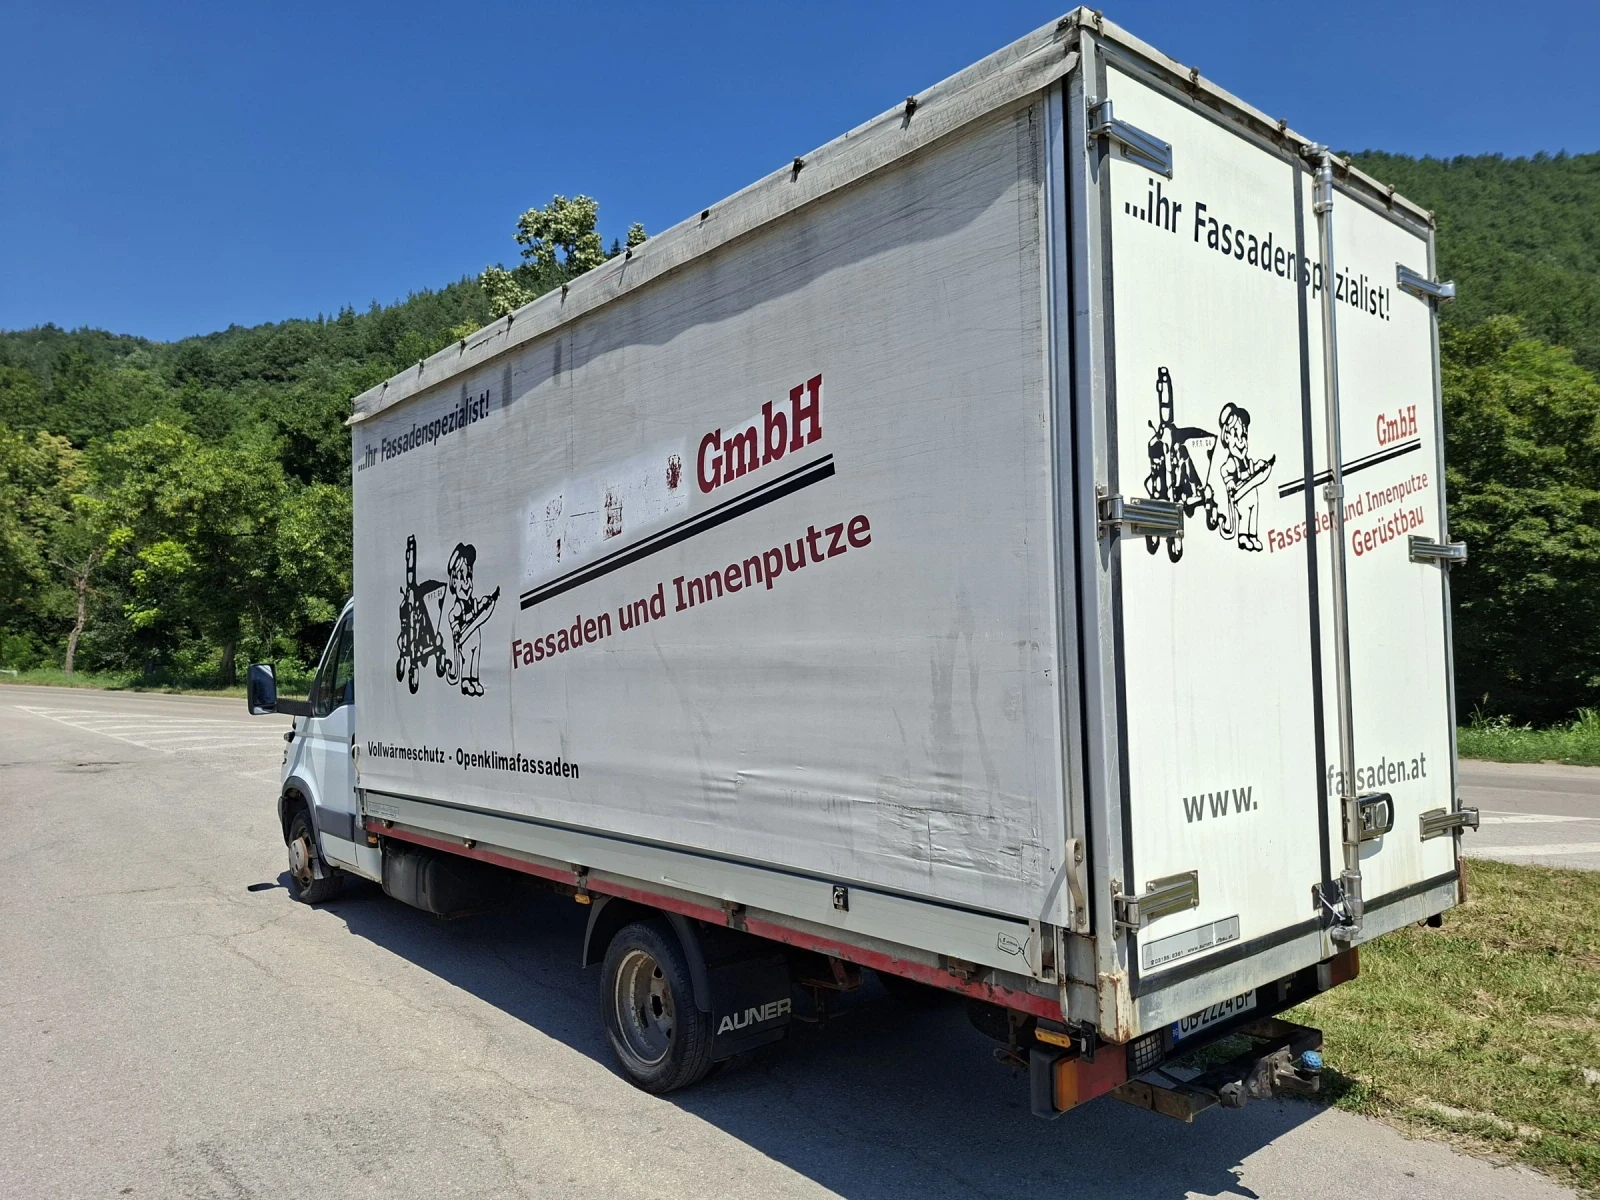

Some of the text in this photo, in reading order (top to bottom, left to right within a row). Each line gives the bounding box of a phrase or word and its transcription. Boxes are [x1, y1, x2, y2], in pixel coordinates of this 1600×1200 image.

[1125, 178, 1390, 321] ...ihr Fassadenspzialist!
[357, 390, 490, 472] ...ihr Fassadenspezialist!
[697, 373, 822, 494] GmbH
[1376, 404, 1418, 447] GmbH
[1343, 494, 1364, 523] und
[1366, 473, 1429, 512] Innenputze
[1352, 505, 1424, 556] Gerüstbau
[512, 614, 612, 669] Fassaden
[618, 583, 666, 631] und
[673, 514, 873, 612] Innenputze
[368, 741, 445, 763] Vollwärmeschutz
[456, 748, 580, 779] Openklimafassaden
[1183, 752, 1427, 823] www. fasaden.at
[717, 998, 792, 1035] AUNER
